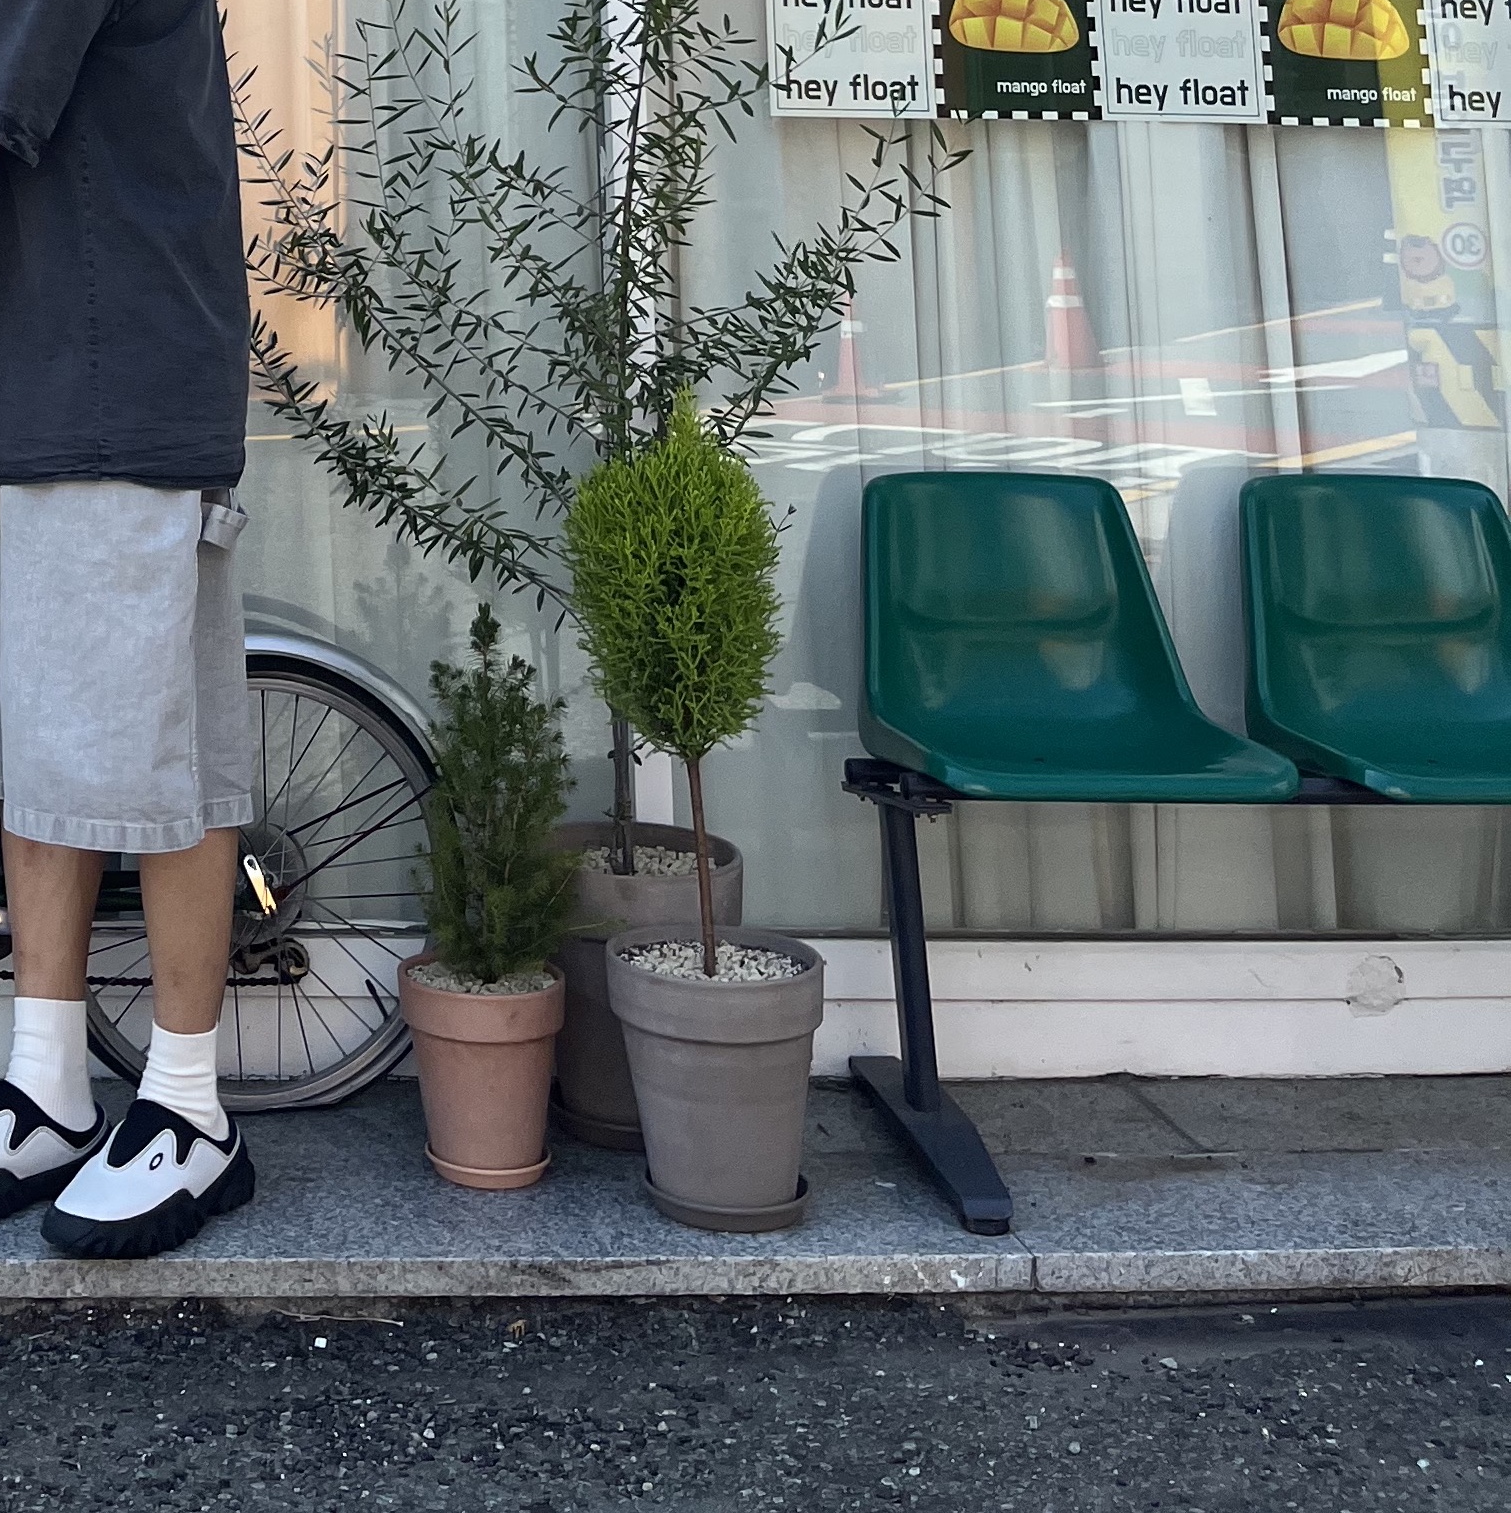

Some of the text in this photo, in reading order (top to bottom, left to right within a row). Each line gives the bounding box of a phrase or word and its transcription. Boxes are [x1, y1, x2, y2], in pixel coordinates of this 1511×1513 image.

[786, 74, 919, 106] hey float
[997, 80, 1086, 96] mango float
[1116, 78, 1248, 111] hey float
[1327, 87, 1416, 103] mango float
[1449, 85, 1501, 118] hey
